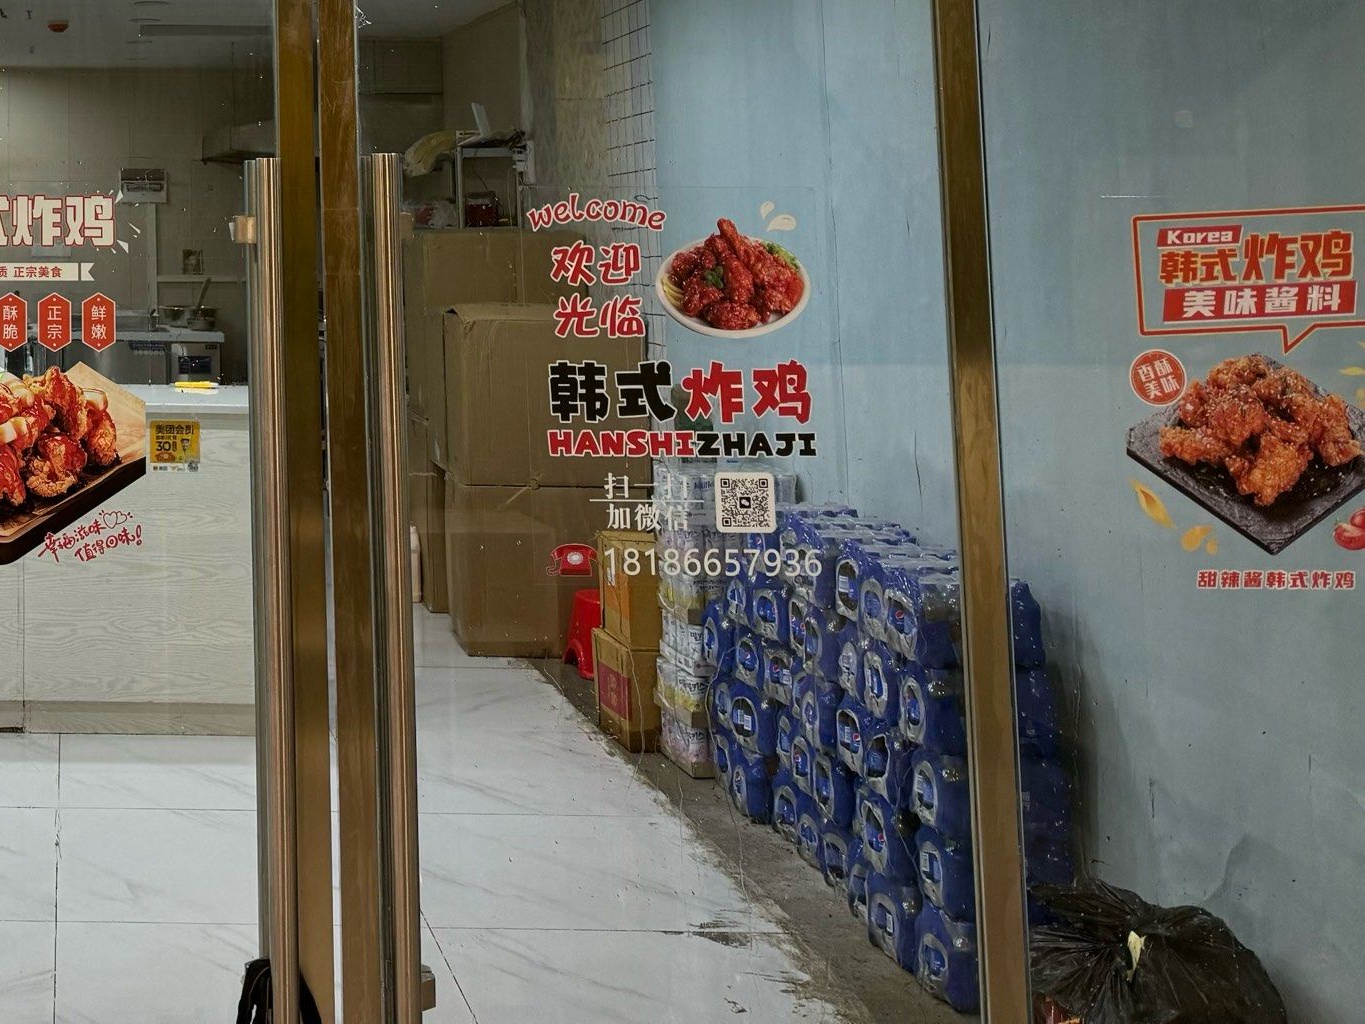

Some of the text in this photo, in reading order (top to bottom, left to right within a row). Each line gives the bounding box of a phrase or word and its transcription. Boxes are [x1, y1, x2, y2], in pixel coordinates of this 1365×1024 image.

[527, 193, 666, 231] welcome
[1167, 229, 1233, 245] Korea
[13, 266, 63, 278] 正宗美食
[550, 240, 641, 286] 欢迎
[1158, 230, 1354, 285] 韩式炸鸡
[554, 293, 647, 338] 光临
[1182, 284, 1341, 318] 美味酱料
[2, 305, 18, 340] 酥脆
[47, 305, 62, 340] 正宗
[91, 305, 107, 340] 鲜嫩
[548, 360, 813, 424] 韩式炸鸡
[1144, 375, 1180, 399] 美味
[547, 429, 818, 457] HANSHIZHAJI
[606, 503, 688, 532] 加微信
[604, 548, 822, 576] 18186657936
[1197, 570, 1356, 590] 甜辣酱韩式炸鸡
